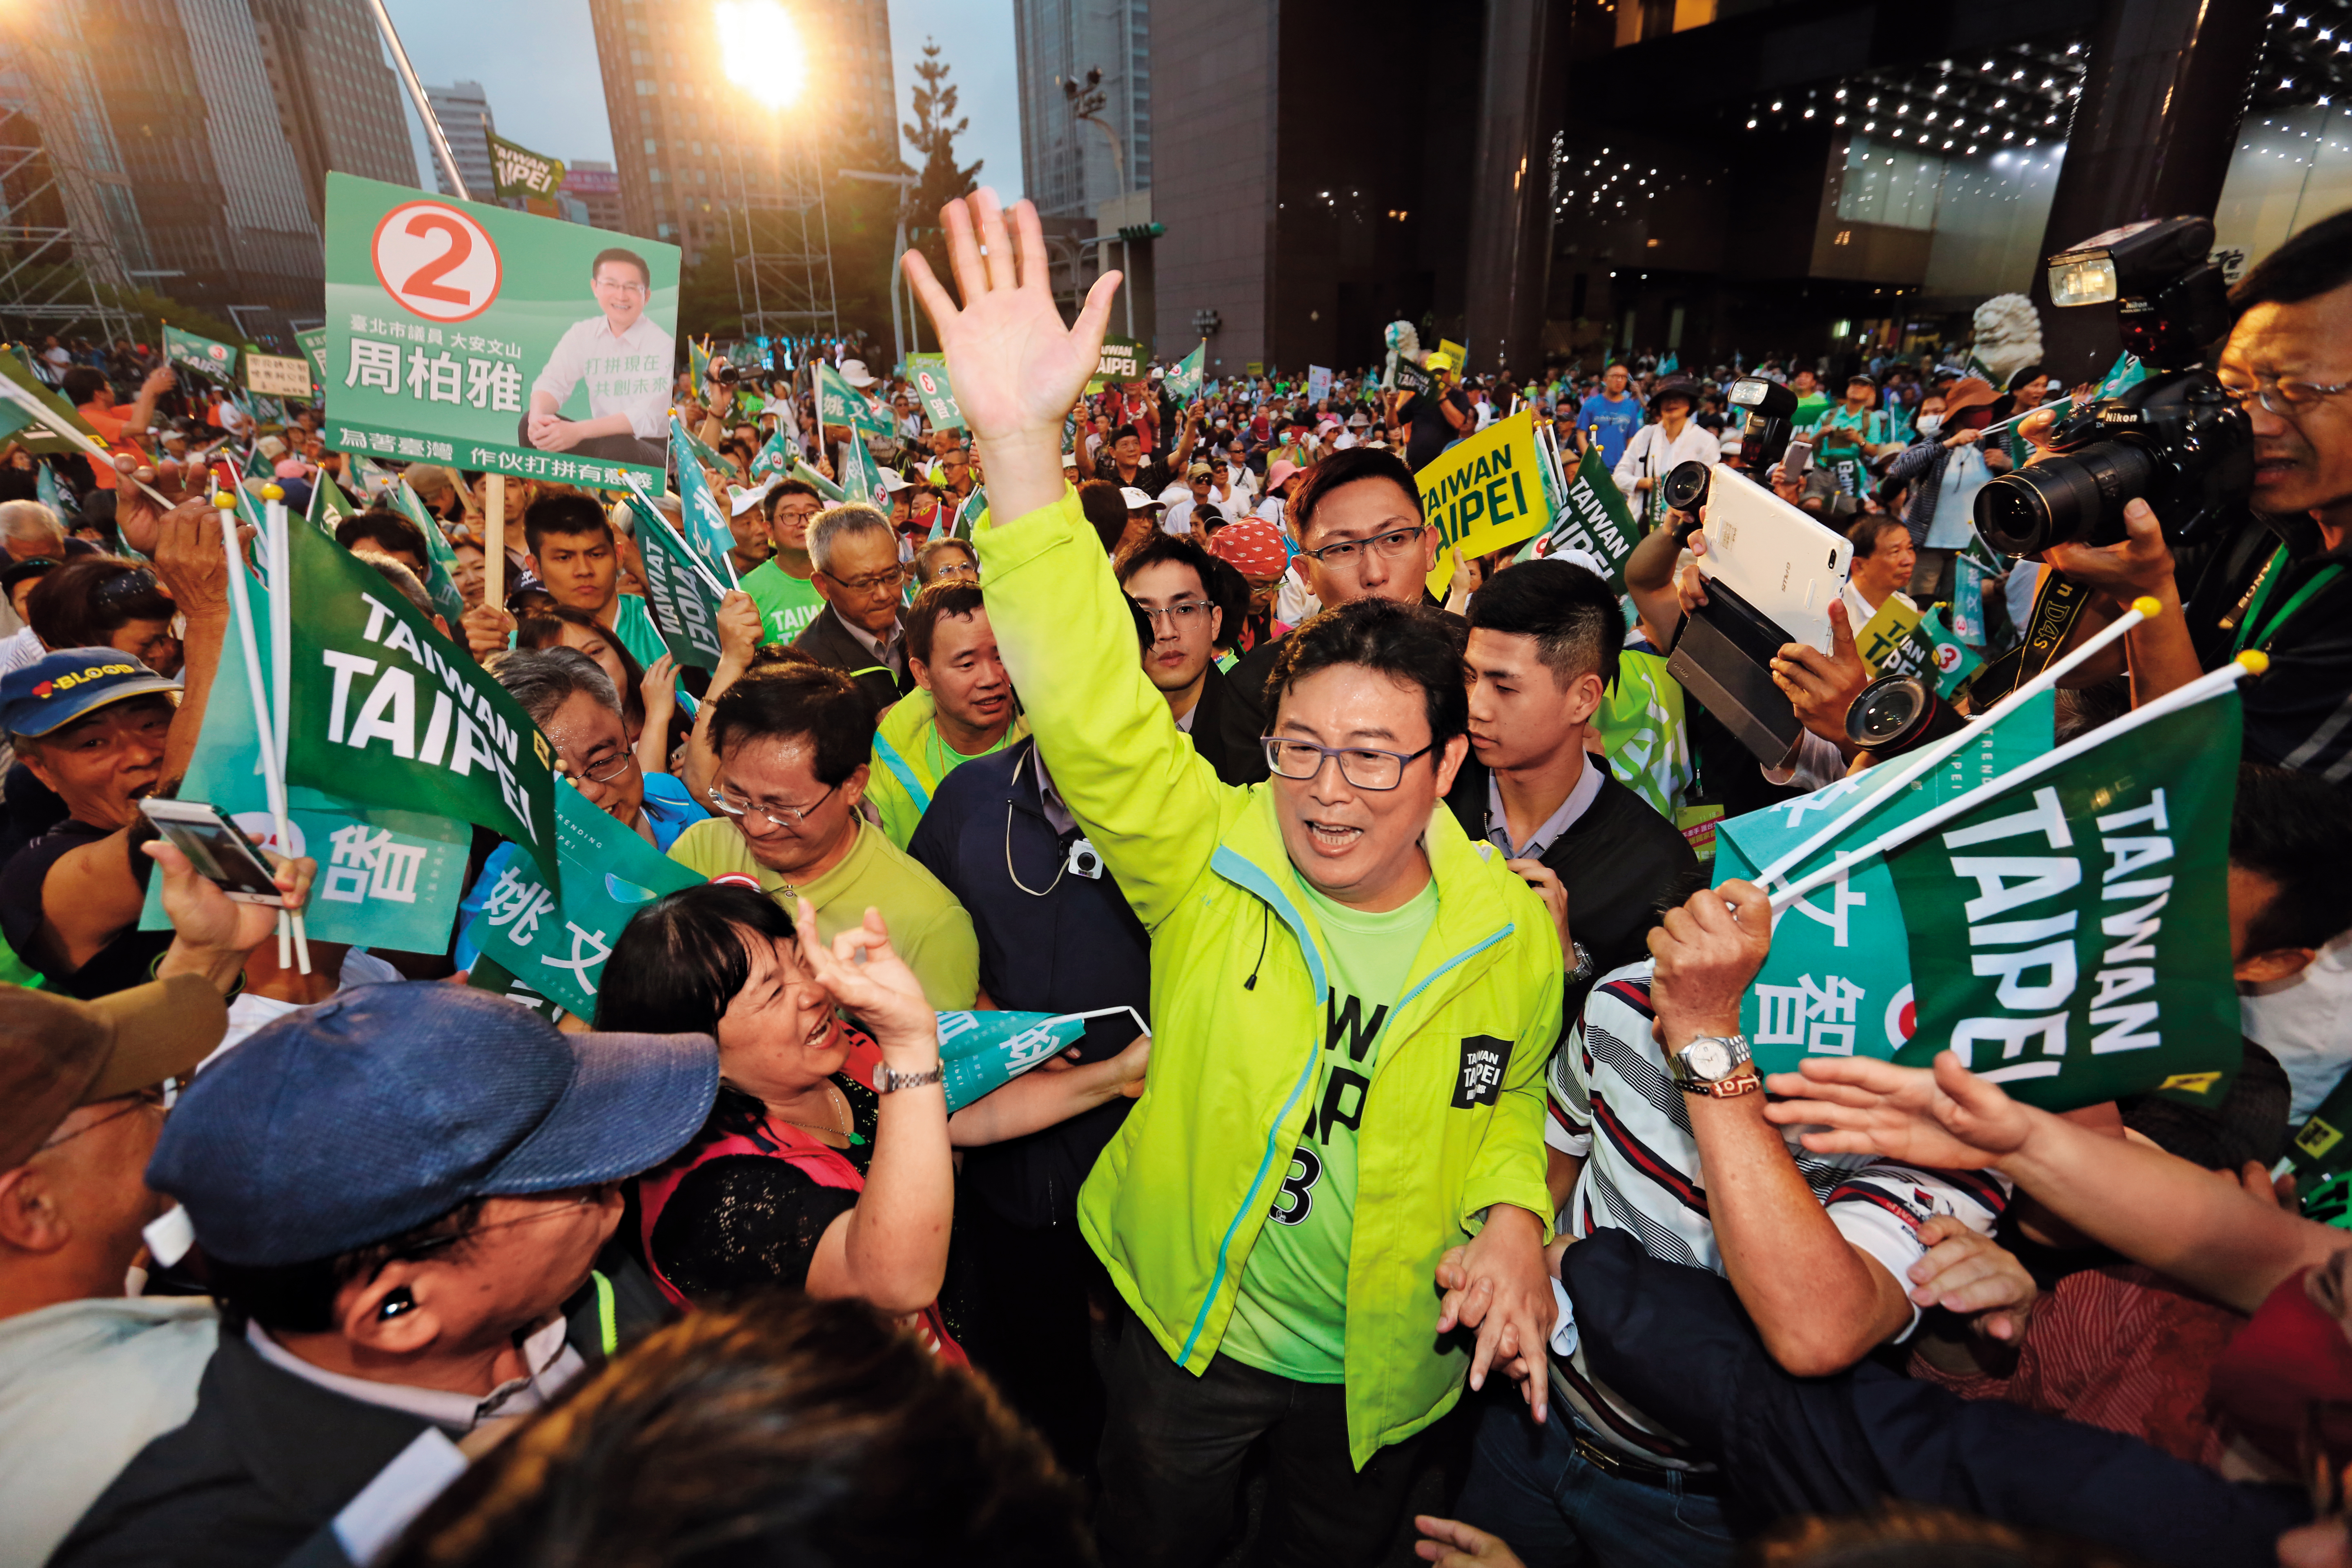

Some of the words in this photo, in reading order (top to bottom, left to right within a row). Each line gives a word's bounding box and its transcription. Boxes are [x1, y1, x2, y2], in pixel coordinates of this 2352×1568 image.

[401, 213, 472, 306] 2
[212, 348, 224, 361] 3
[350, 313, 443, 346] 臺北市議員
[450, 332, 522, 360] 大安文山
[1100, 345, 1133, 357] AIWAN
[344, 337, 523, 413] 周柏雅
[585, 354, 659, 375] 打拼現在
[595, 372, 668, 397] 共創未來
[1095, 357, 1137, 376] AIPEI
[2105, 412, 2138, 422] Nikon
[340, 427, 453, 461] 為著臺灣
[470, 447, 653, 490] 作伙打拼有意義
[1838, 461, 1854, 496] AIPEI
[1425, 471, 1528, 563] AIPEI
[1570, 475, 1630, 560] TAIWAN
[771, 604, 825, 631] TAIW
[2034, 600, 2070, 649] D4s
[361, 592, 519, 766] TAIWAN
[1940, 648, 1957, 669] 3
[323, 650, 538, 846] TAIPEI
[1950, 754, 1962, 789] IPEI
[1981, 728, 1994, 785] TREND
[554, 808, 602, 849] RENDING
[555, 831, 575, 849] PEI
[481, 865, 612, 996] 姚文
[1942, 786, 2083, 1084] TAIPEI
[2089, 787, 2175, 1055] TAIWAN
